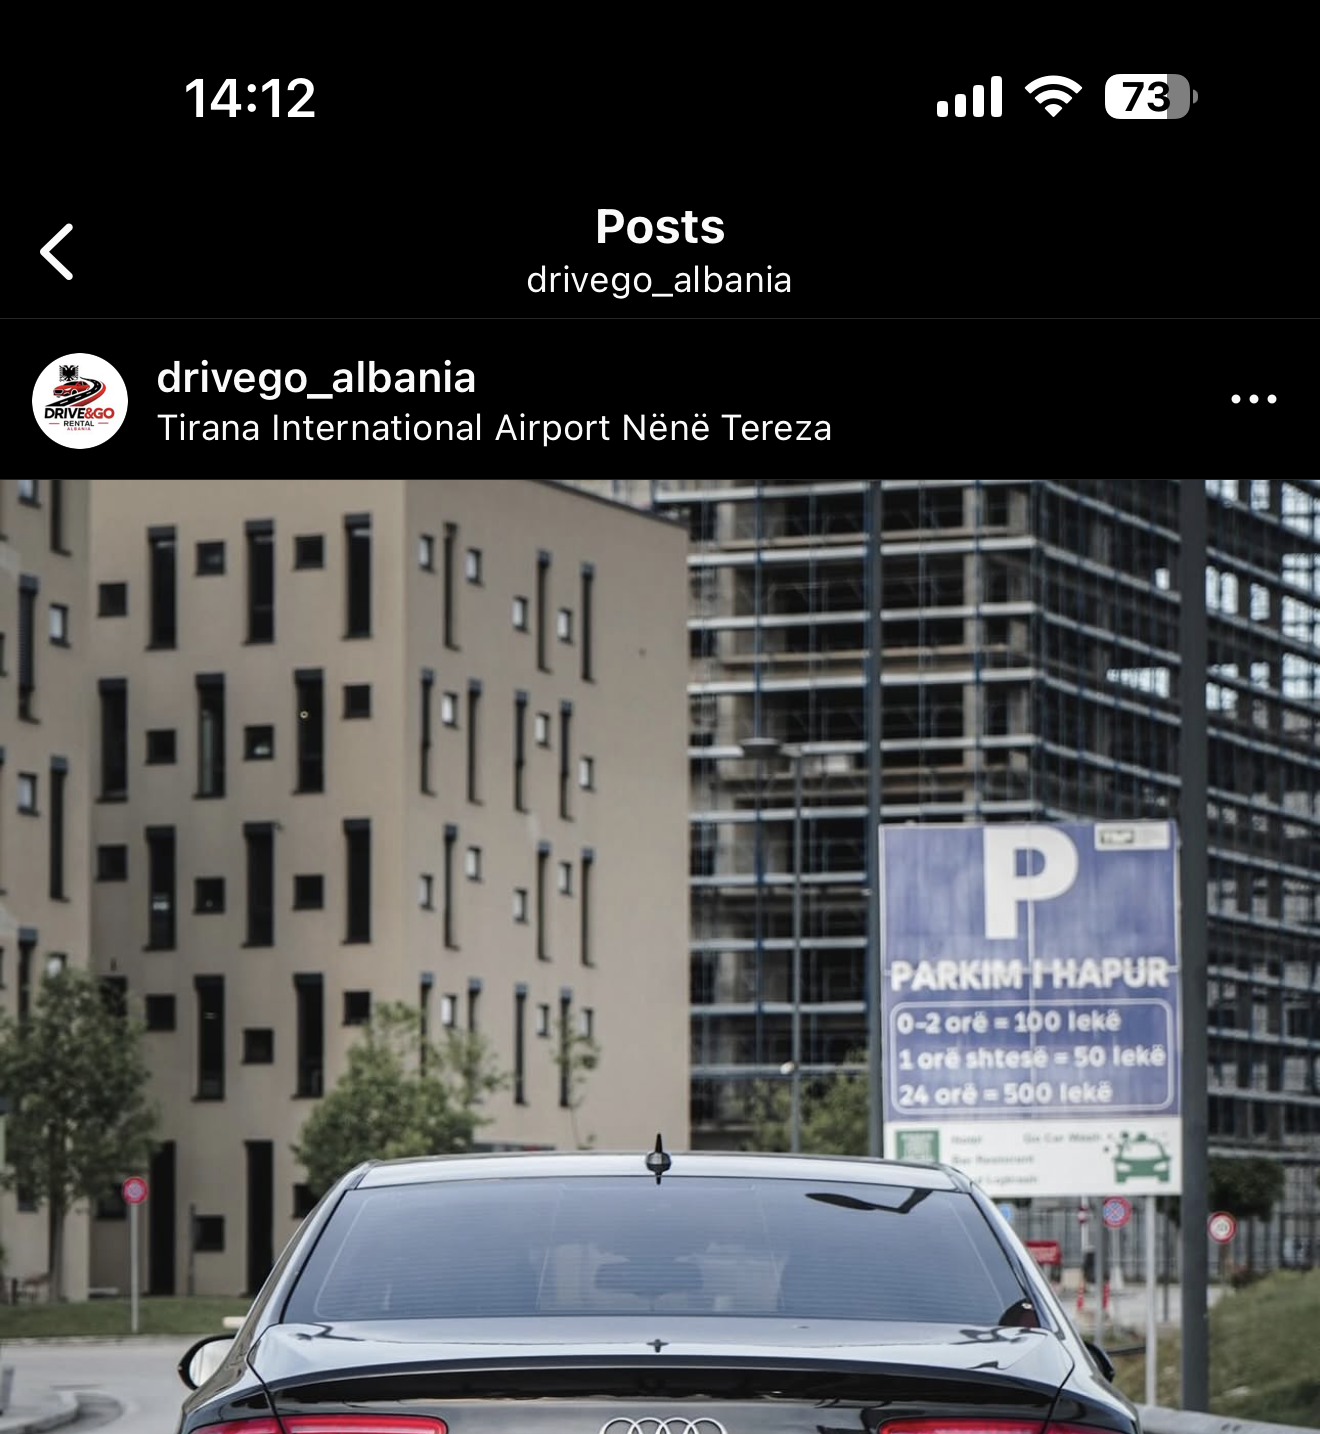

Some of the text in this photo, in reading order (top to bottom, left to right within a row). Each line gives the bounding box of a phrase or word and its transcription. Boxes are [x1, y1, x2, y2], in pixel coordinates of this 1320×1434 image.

[185, 77, 316, 118] 14:12
[1122, 81, 1171, 112] 73
[597, 208, 725, 245] Posts
[527, 264, 791, 300] drivego_albania
[157, 359, 475, 401] drivego_albania
[44, 407, 115, 419] DRIVE&GO
[157, 412, 831, 447] Tirana International Airport Nënë Tereza
[983, 826, 1079, 940] P
[890, 957, 1170, 992] PARKIM I HAPUR
[897, 1009, 1122, 1035] 0-2 orë = 100 lekë
[900, 1044, 1167, 1071] 1 orë shtesë = 50 lekë
[900, 1080, 1114, 1107] 24 orë = 500 lekë
